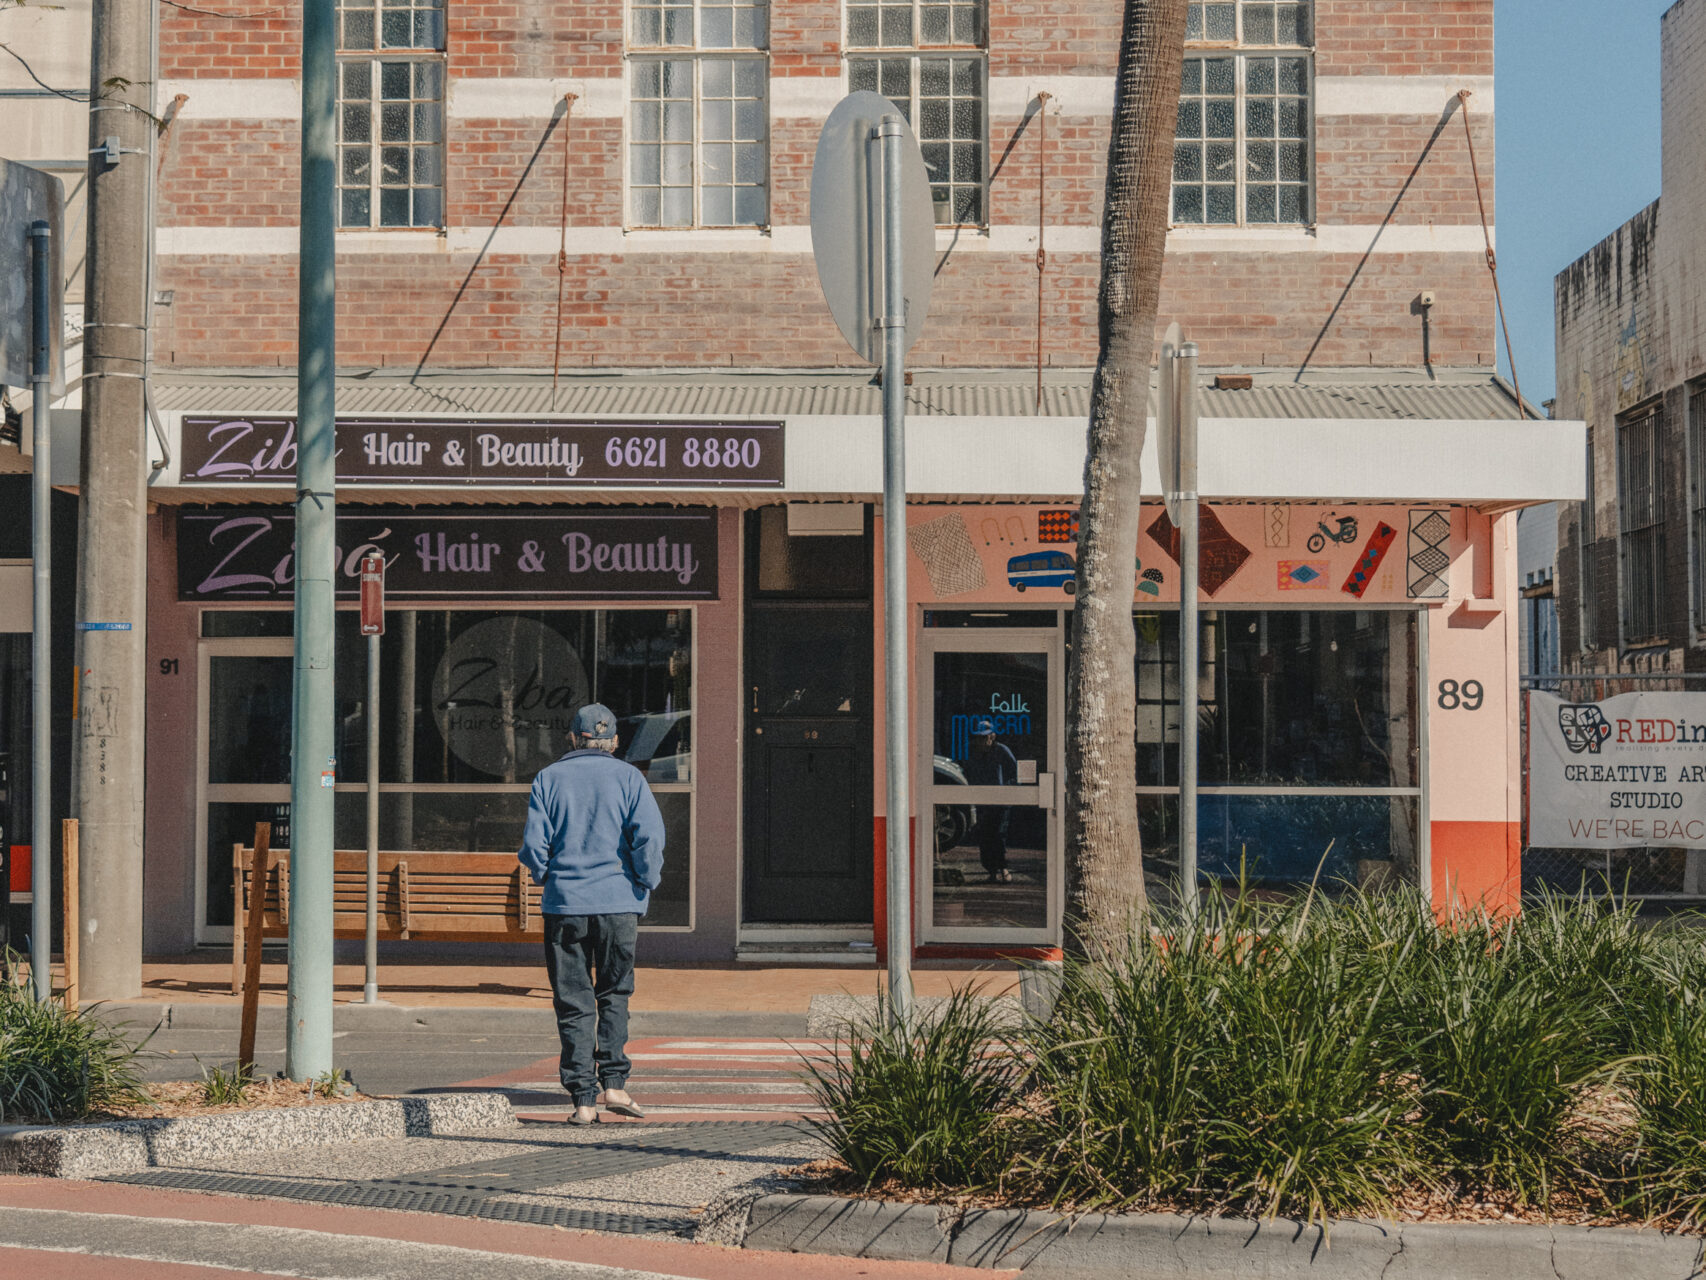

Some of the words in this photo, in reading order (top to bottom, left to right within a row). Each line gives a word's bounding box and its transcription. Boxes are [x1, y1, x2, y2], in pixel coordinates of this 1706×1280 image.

[197, 421, 343, 477] Zib
[363, 433, 431, 465] Hair
[442, 440, 465, 466] &
[477, 434, 583, 476] Beauty
[605, 437, 667, 468] 6621
[682, 438, 761, 468] 8880
[414, 532, 501, 572] Hair
[518, 540, 545, 572] &
[562, 532, 699, 585] Beauty
[159, 658, 179, 675] 91
[1437, 679, 1484, 711] 89
[1565, 765, 1667, 782] CREATIVE
[1678, 765, 1706, 782] AR
[1610, 792, 1683, 809] STUDIO
[1568, 817, 1644, 839] WE'RE
